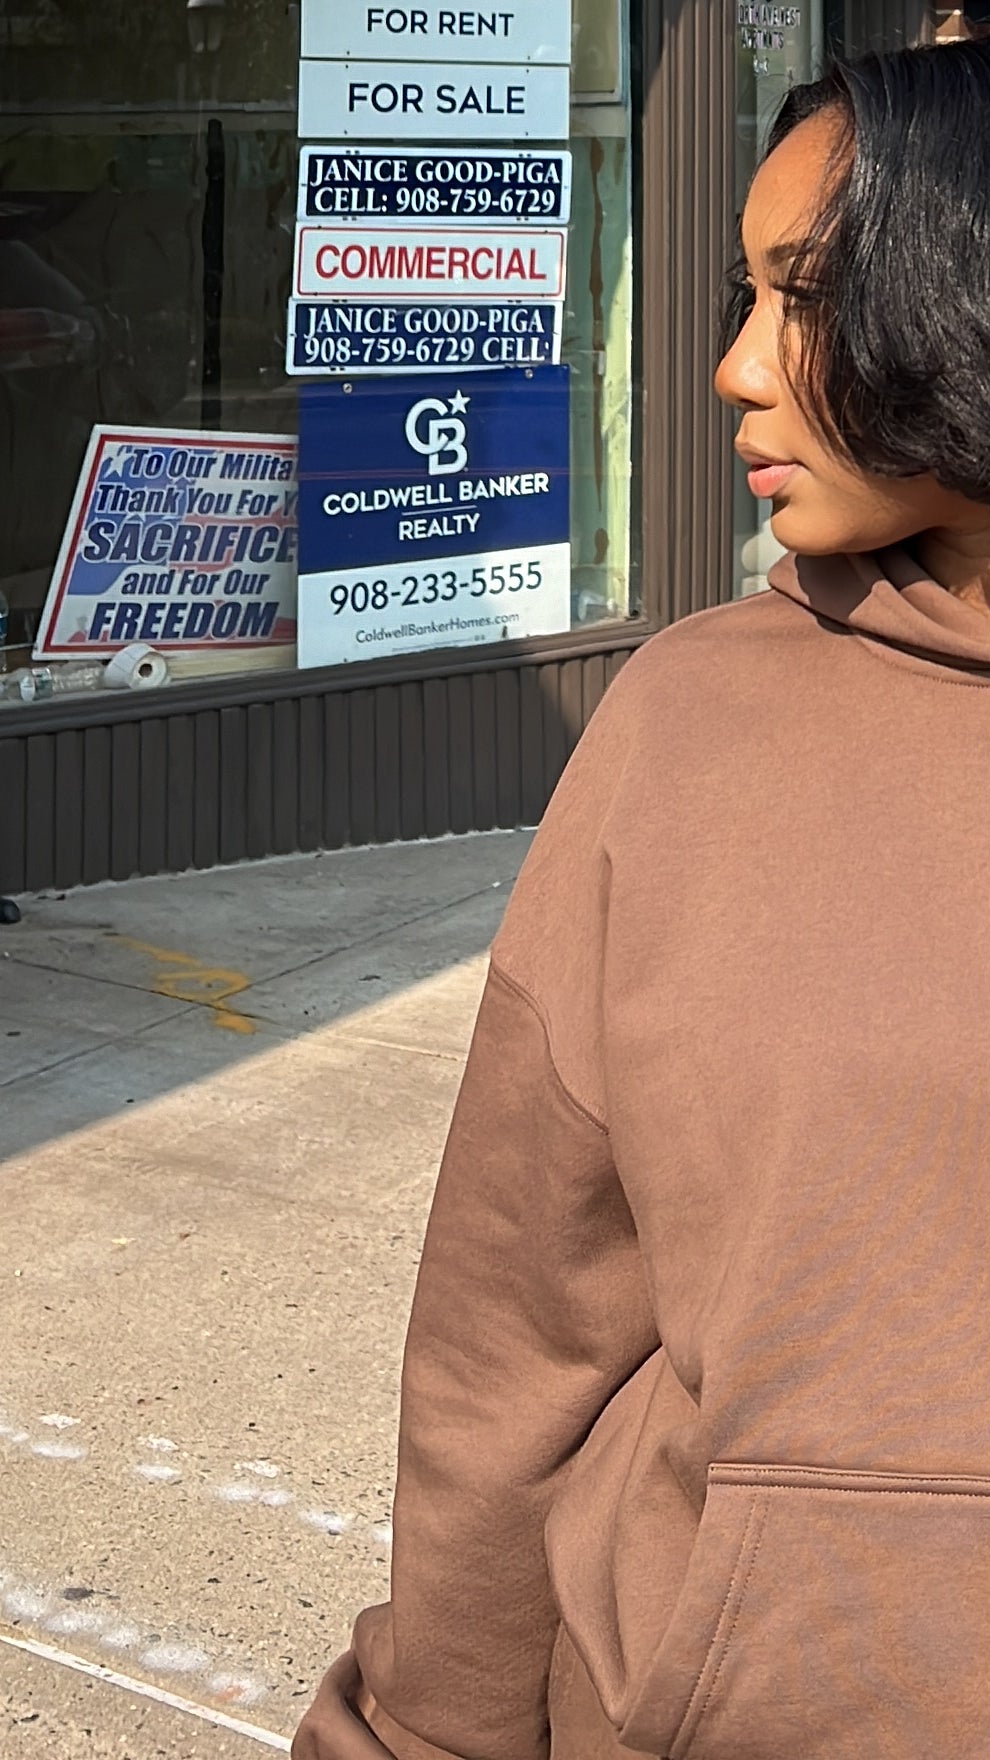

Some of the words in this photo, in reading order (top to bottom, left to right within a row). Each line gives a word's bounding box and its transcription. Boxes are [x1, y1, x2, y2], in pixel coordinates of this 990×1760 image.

[366, 8, 428, 34] FOR
[438, 11, 515, 37] RENT
[348, 83, 424, 114] FOR
[436, 84, 526, 115] SALE
[310, 158, 408, 187] JANICE
[415, 159, 561, 185] GOOD-PIGA
[314, 188, 388, 213] CELL:
[396, 188, 556, 214] 908-759-6729
[315, 244, 547, 281] COMMERCIAL
[303, 307, 398, 339] JANICE
[404, 308, 545, 334] GOOD-PIGA
[304, 337, 475, 364] 908-759-6729
[131, 448, 164, 478] To
[168, 449, 217, 479] Our
[219, 452, 298, 482] Milita
[95, 484, 181, 514] Thank
[186, 488, 231, 516] You
[236, 489, 280, 516] For
[322, 483, 453, 516] COLDWELL
[459, 472, 550, 502] BANKER
[399, 512, 481, 541] REALTY
[121, 569, 177, 595] and
[178, 569, 222, 595] For
[223, 569, 271, 595] Our
[330, 560, 543, 616] 908-233-5555
[87, 601, 280, 641] FREEDOM
[355, 612, 520, 644] ColdwellBankerHomes.com
